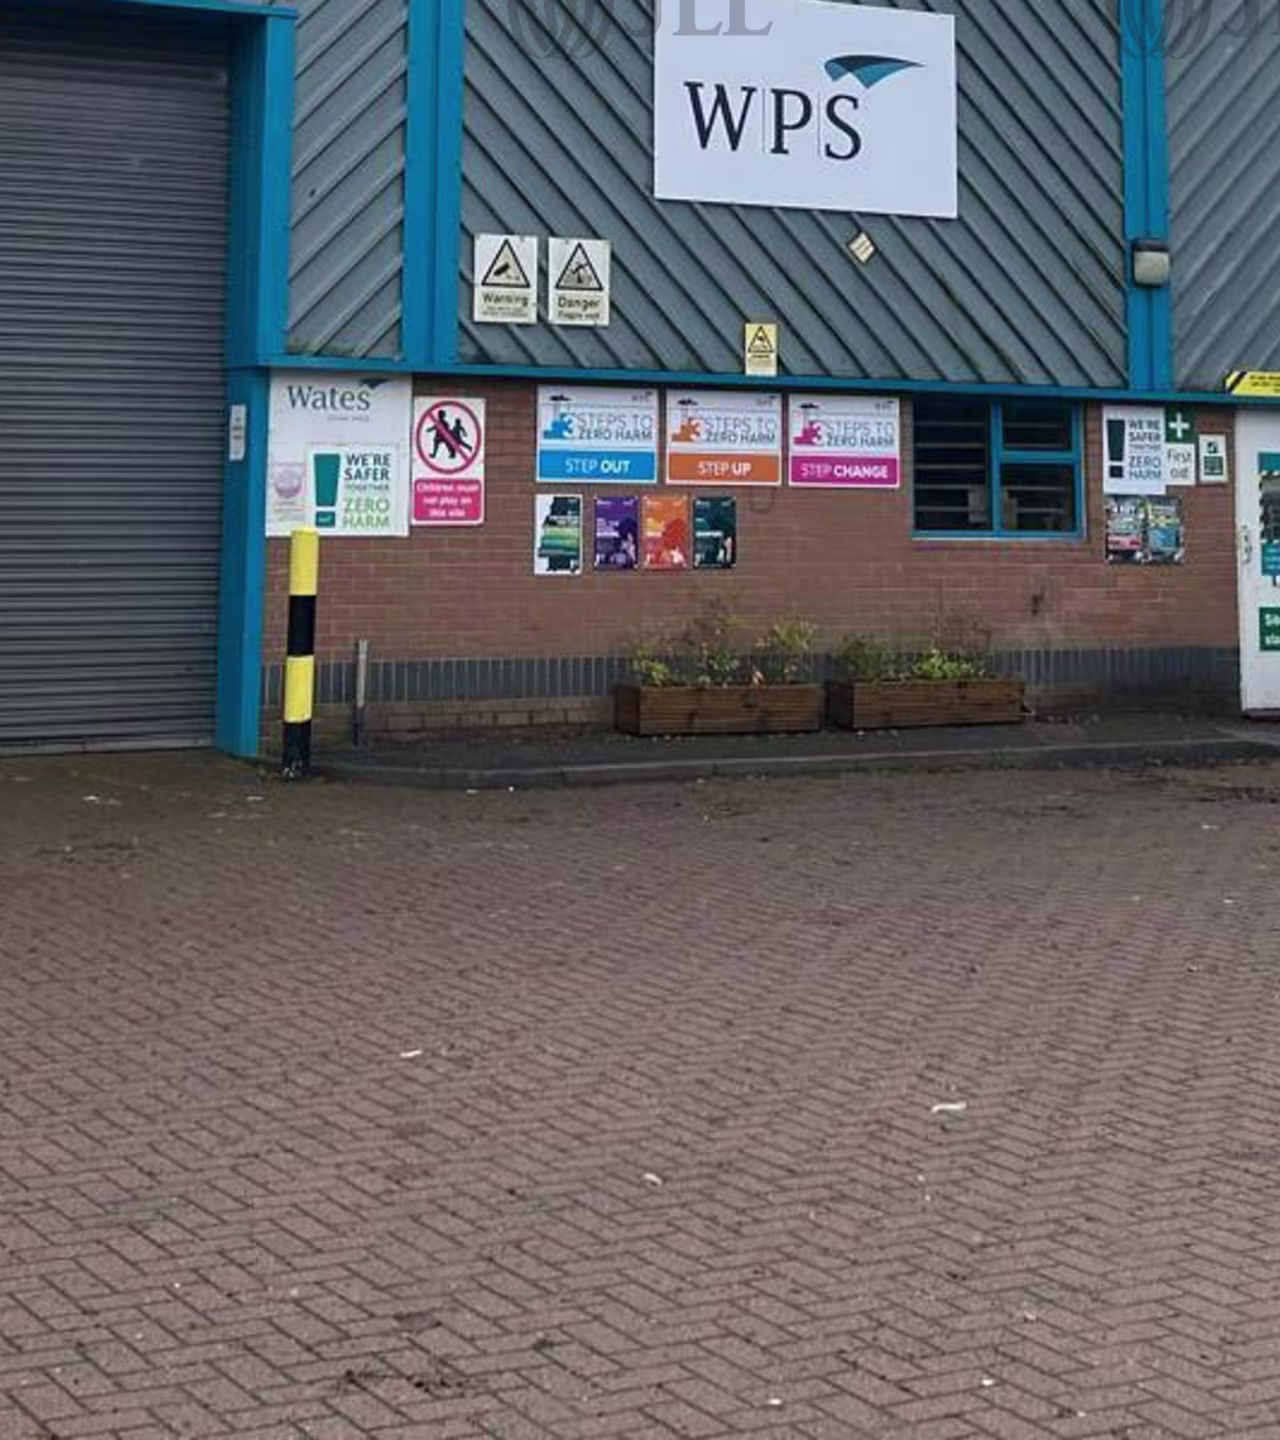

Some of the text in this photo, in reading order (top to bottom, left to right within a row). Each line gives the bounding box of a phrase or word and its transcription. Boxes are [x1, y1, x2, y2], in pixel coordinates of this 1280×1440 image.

[683, 80, 862, 161] WPS
[483, 292, 528, 307] Warning
[558, 296, 600, 311] Danger
[287, 385, 370, 411] Wates
[563, 414, 653, 438] 3 STEPS TO
[690, 417, 776, 441] 3 STEPS TO
[811, 420, 895, 445] 3 STEPS TO
[579, 428, 652, 441] ZERO HARM
[705, 431, 776, 444] ZERO HARM
[826, 435, 895, 447] ZERO HARM
[1128, 431, 1161, 442] SAFER
[1129, 456, 1162, 468] ZERO
[1167, 448, 1192, 462] First
[565, 458, 631, 474] STEP OUT
[698, 461, 752, 476] STEP UP
[801, 463, 889, 479] STEP CHANGE
[1169, 468, 1189, 479] aid
[344, 467, 390, 481] SAFER
[1129, 468, 1162, 480] HARM
[344, 497, 391, 513] ZERO
[343, 515, 390, 528] HARM
